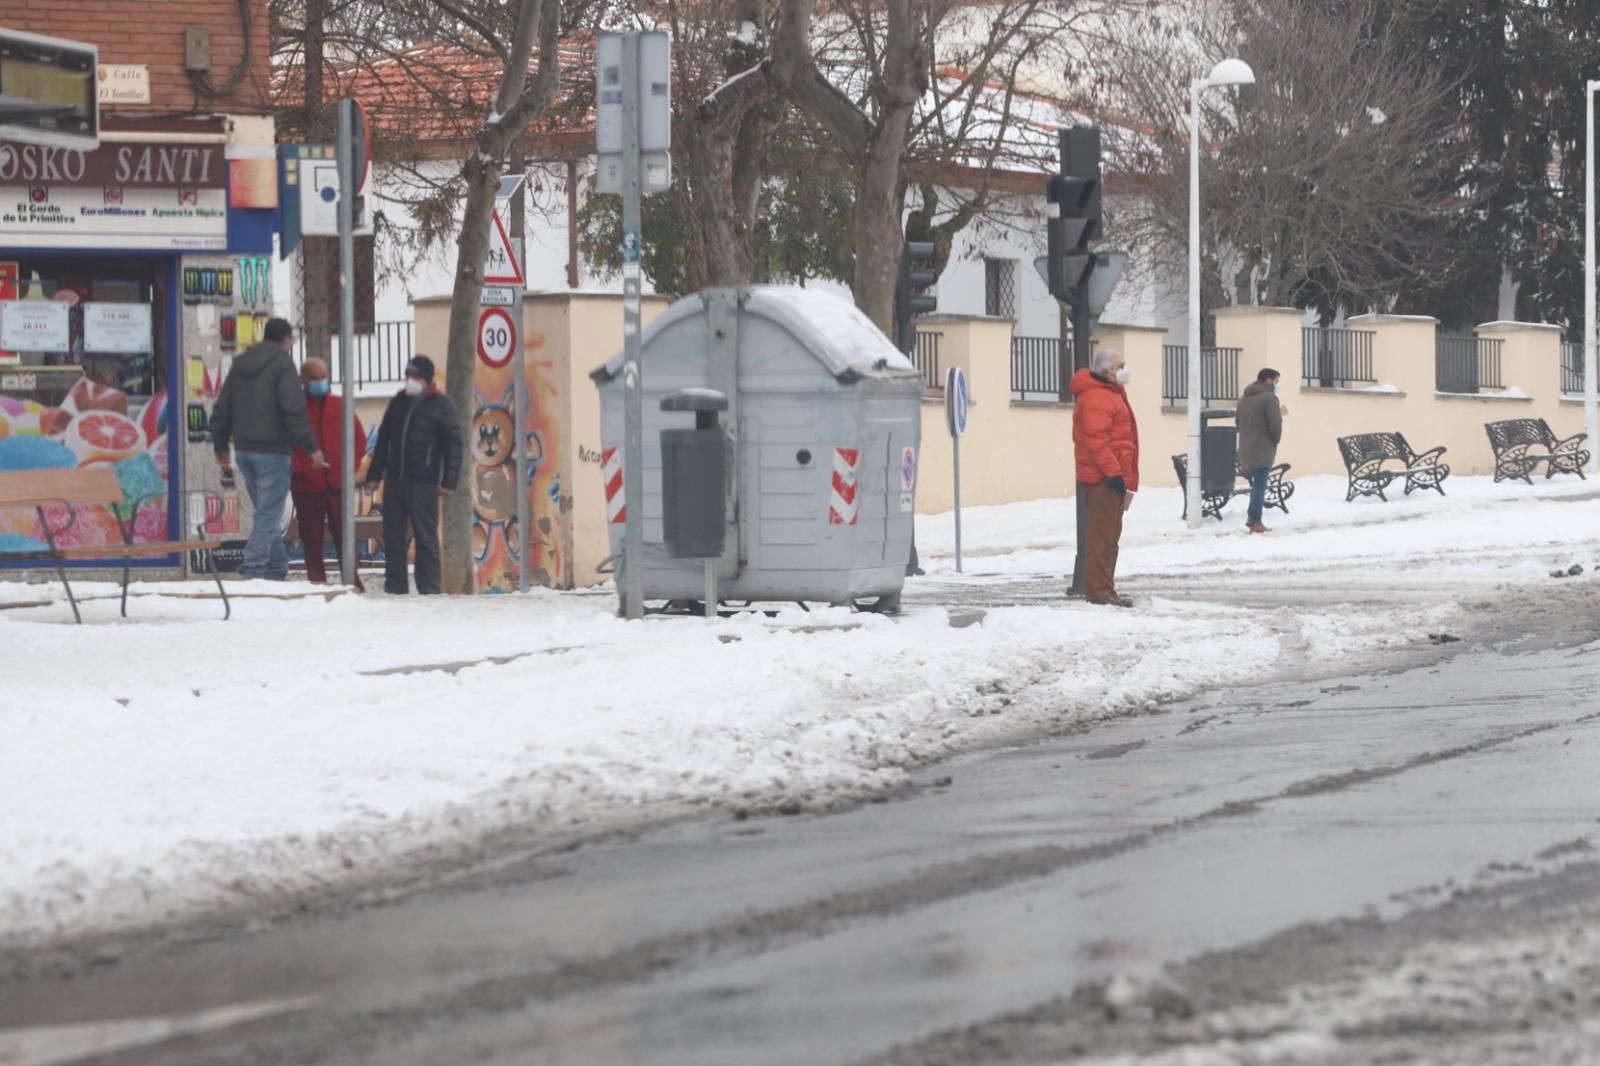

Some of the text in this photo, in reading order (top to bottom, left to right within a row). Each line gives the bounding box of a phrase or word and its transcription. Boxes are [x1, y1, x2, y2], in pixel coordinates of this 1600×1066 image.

[113, 68, 141, 79] Calle
[99, 88, 109, 98] El
[115, 146, 213, 183] SANTI
[16, 204, 61, 213] El Gordo
[80, 207, 147, 217] EuroMillones
[152, 207, 193, 218] Apuesta
[3, 213, 76, 224] de la Primitiva
[486, 328, 508, 347] 30
